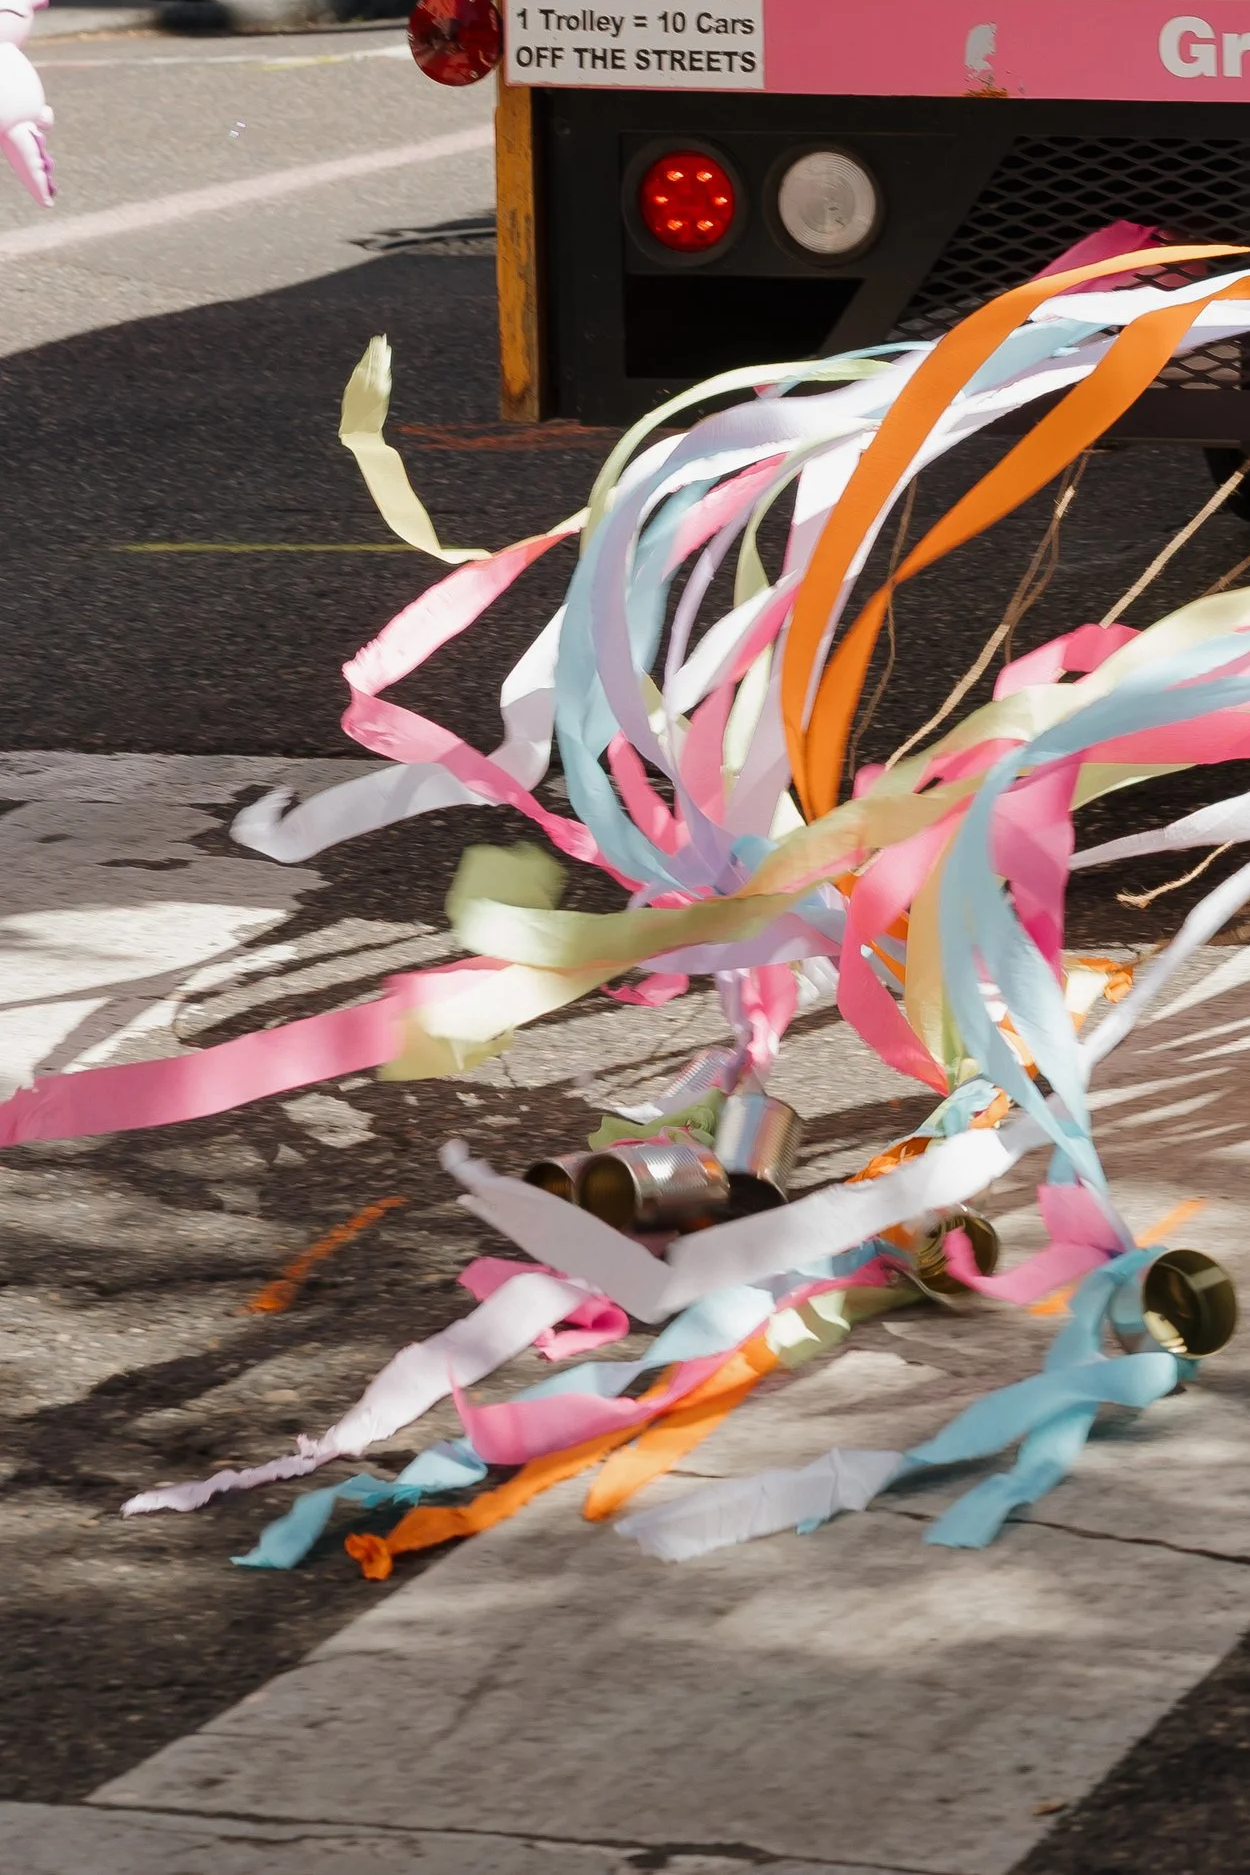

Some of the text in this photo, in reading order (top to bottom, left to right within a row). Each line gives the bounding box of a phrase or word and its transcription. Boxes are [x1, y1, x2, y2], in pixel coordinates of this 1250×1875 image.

[516, 8, 528, 30] 1
[538, 8, 624, 38] Trolley
[657, 11, 686, 34] 10
[696, 12, 755, 35] Cars
[516, 46, 757, 73] OFF THE STREETS
